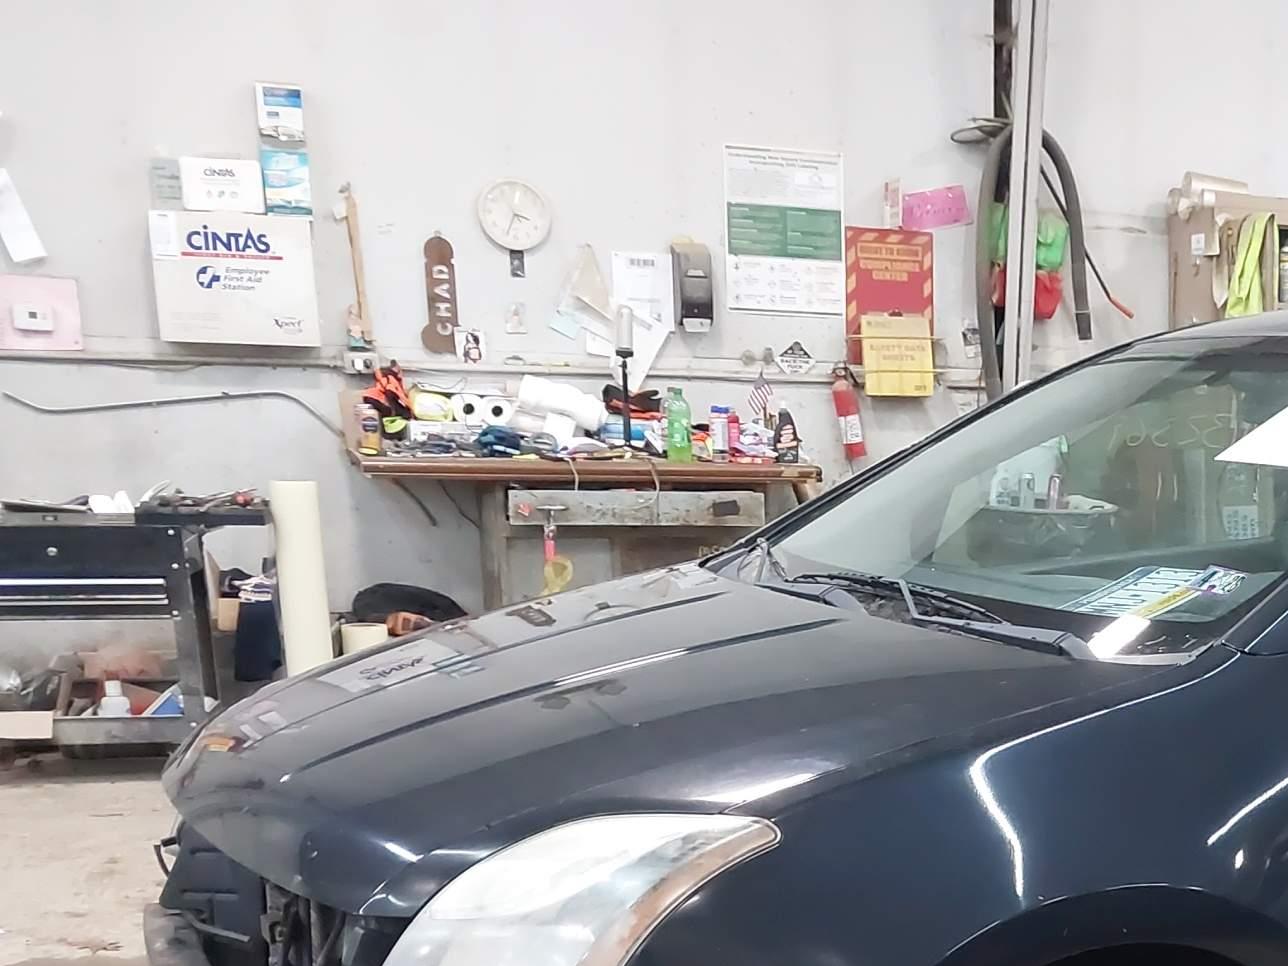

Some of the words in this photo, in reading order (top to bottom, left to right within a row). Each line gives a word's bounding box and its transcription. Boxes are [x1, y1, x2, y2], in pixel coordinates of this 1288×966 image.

[225, 266, 270, 275] Employee
[224, 275, 245, 283] First
[222, 283, 256, 291] Station
[431, 264, 453, 336] CHAD
